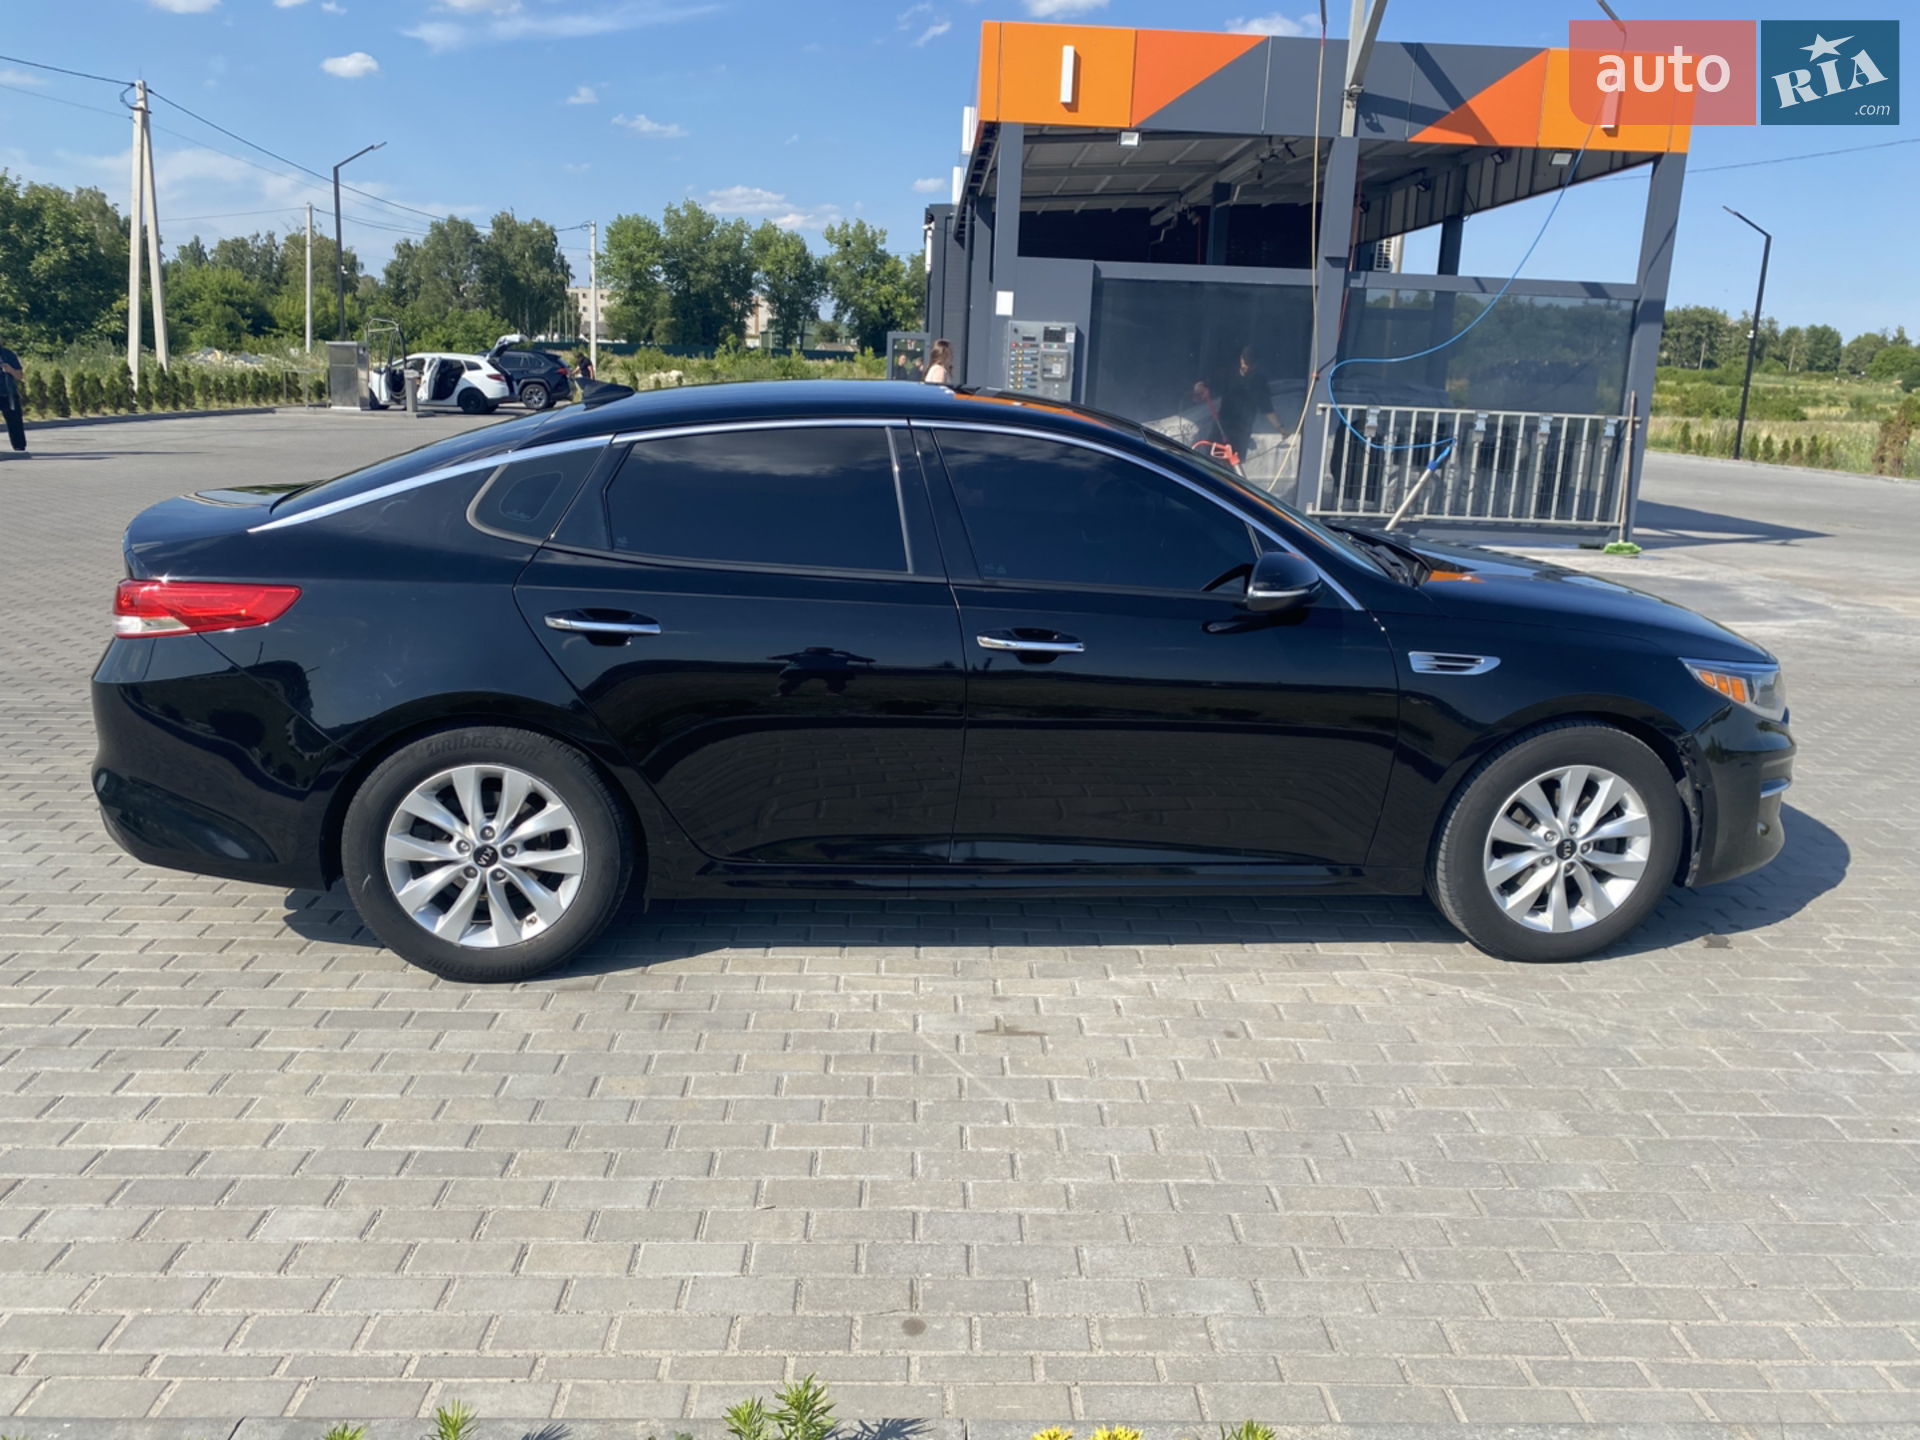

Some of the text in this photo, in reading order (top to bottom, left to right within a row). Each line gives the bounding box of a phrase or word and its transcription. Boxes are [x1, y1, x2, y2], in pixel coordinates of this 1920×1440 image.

[426, 735, 548, 760] BRIDGESTONE
[477, 847, 495, 865] KIA
[1563, 840, 1572, 859] KIA
